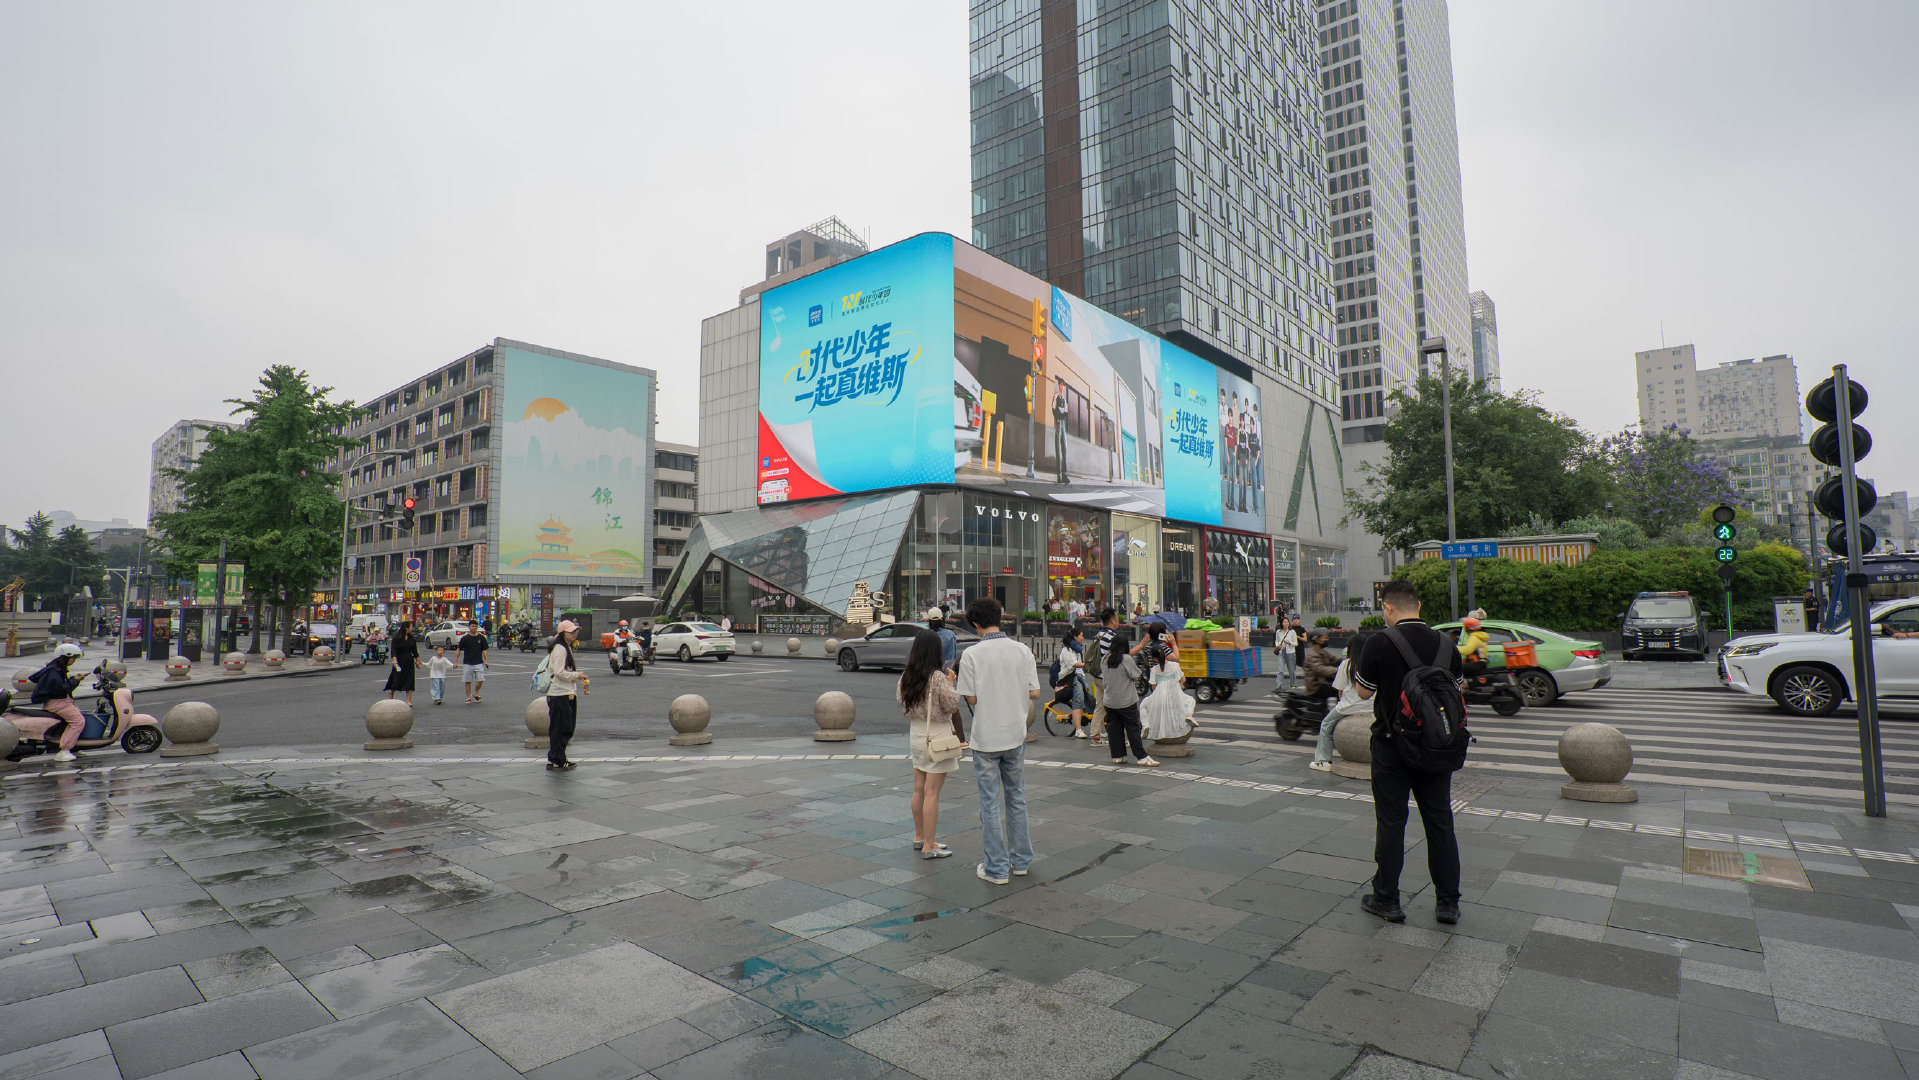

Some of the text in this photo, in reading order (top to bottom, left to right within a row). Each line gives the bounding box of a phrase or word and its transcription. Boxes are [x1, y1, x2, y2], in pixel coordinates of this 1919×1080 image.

[797, 321, 892, 383] 时代少年
[795, 348, 910, 413] 一起真维斯
[1171, 408, 1207, 437] 时代少年
[1170, 433, 1214, 468] 一起真维斯
[591, 487, 624, 531] 锦江
[974, 505, 1039, 522] VOLVO
[1170, 541, 1195, 553] DREAME
[1719, 549, 1733, 560] 22
